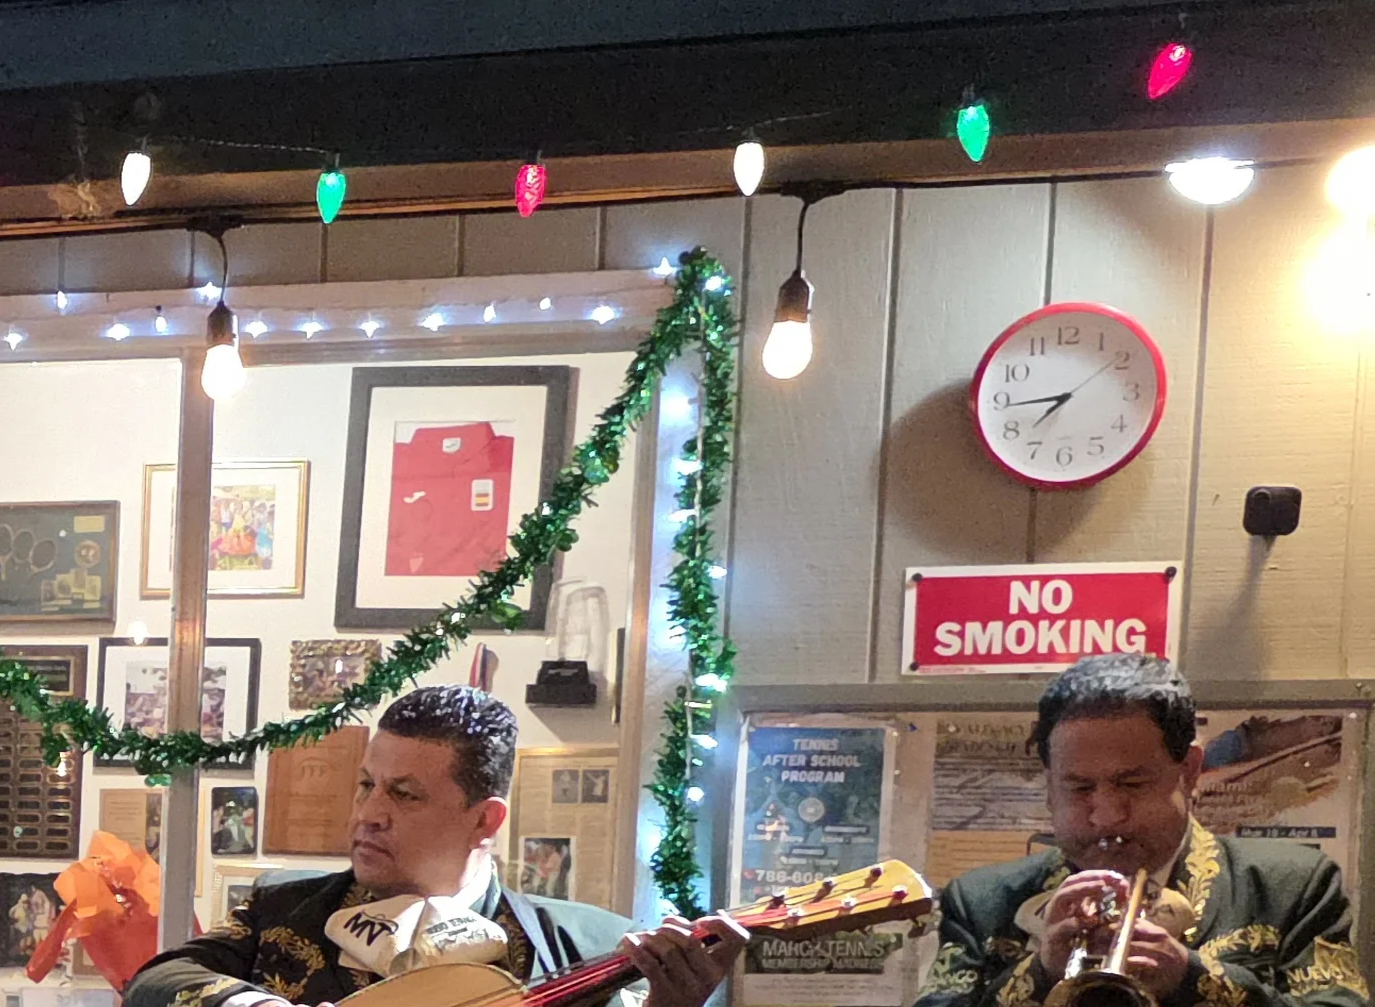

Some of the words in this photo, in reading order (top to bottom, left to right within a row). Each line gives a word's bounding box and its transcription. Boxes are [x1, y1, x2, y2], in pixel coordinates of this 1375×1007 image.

[1057, 326, 1081, 346] 12
[1098, 332, 1105, 351] 1
[1029, 337, 1046, 356] 11
[1114, 352, 1130, 371] 2
[1005, 363, 1030, 383] 10
[993, 391, 1011, 411] 9
[1123, 383, 1140, 402] 3
[1003, 420, 1020, 440] 8
[1110, 414, 1128, 433] 4
[1026, 441, 1043, 460] 7
[1087, 436, 1105, 456] 5
[1056, 446, 1073, 467] 6
[1009, 579, 1073, 614] NO
[933, 618, 1147, 656] SMOKING
[793, 738, 839, 751] TENNIS
[762, 754, 806, 767] AFTER
[810, 754, 862, 767] SCHOOL
[781, 770, 846, 783] PROGRAM
